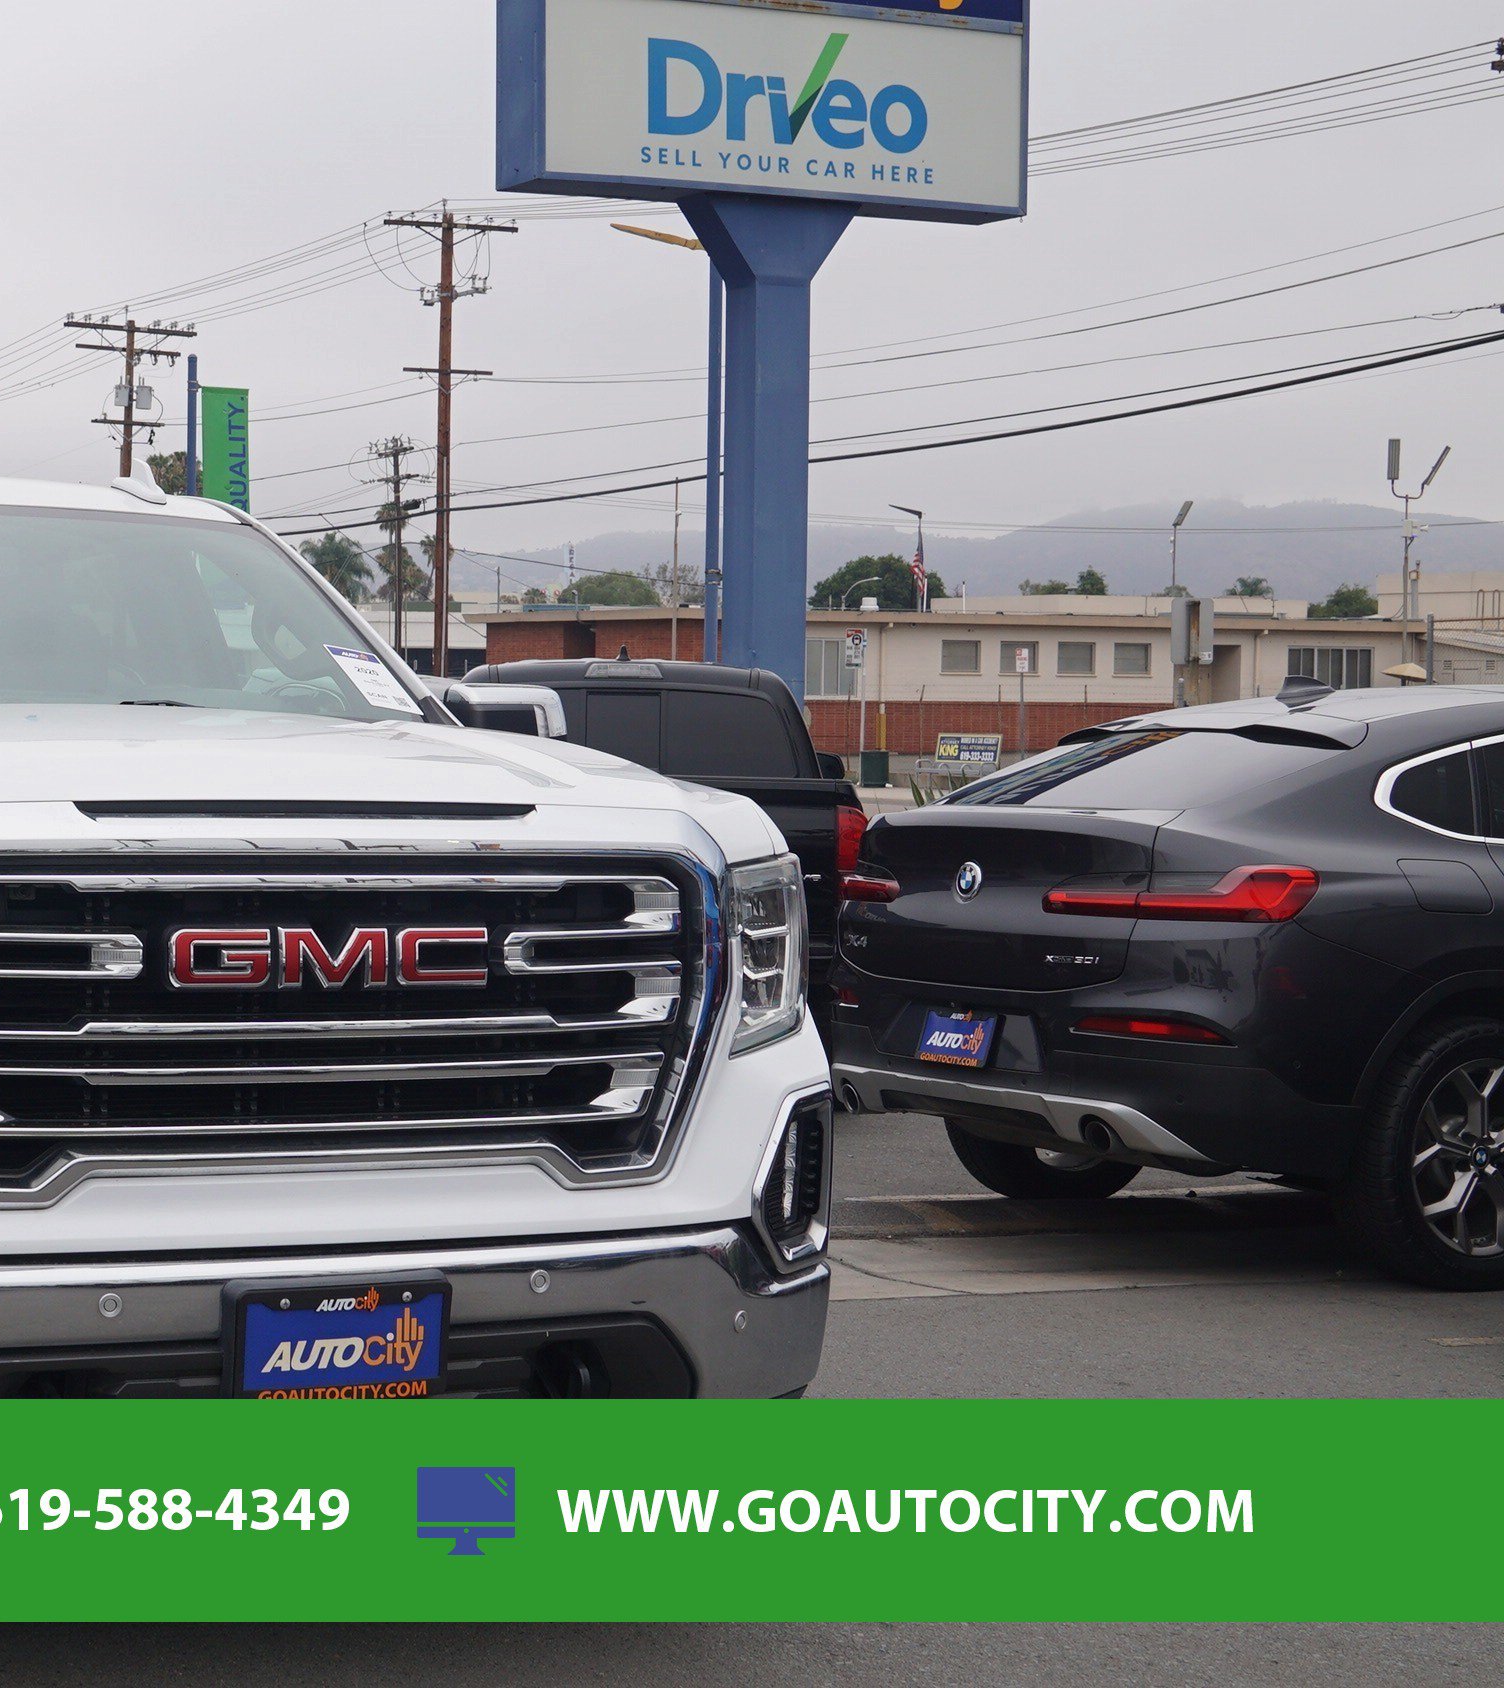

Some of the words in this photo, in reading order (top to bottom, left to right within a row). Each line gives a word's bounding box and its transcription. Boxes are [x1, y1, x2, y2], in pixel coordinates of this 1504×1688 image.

[648, 33, 928, 153] Driveo
[641, 146, 702, 167] SELL
[718, 152, 791, 173] YOUR
[806, 159, 856, 179] CAR
[872, 164, 935, 185] HERE
[168, 926, 489, 989] GMC
[846, 934, 868, 948] X4
[926, 1022, 985, 1055] AUTOCity
[920, 1052, 978, 1067] GOAUTOCITY.COM
[316, 1286, 380, 1313] AUTOCity
[261, 1307, 425, 1373] AUTOCity
